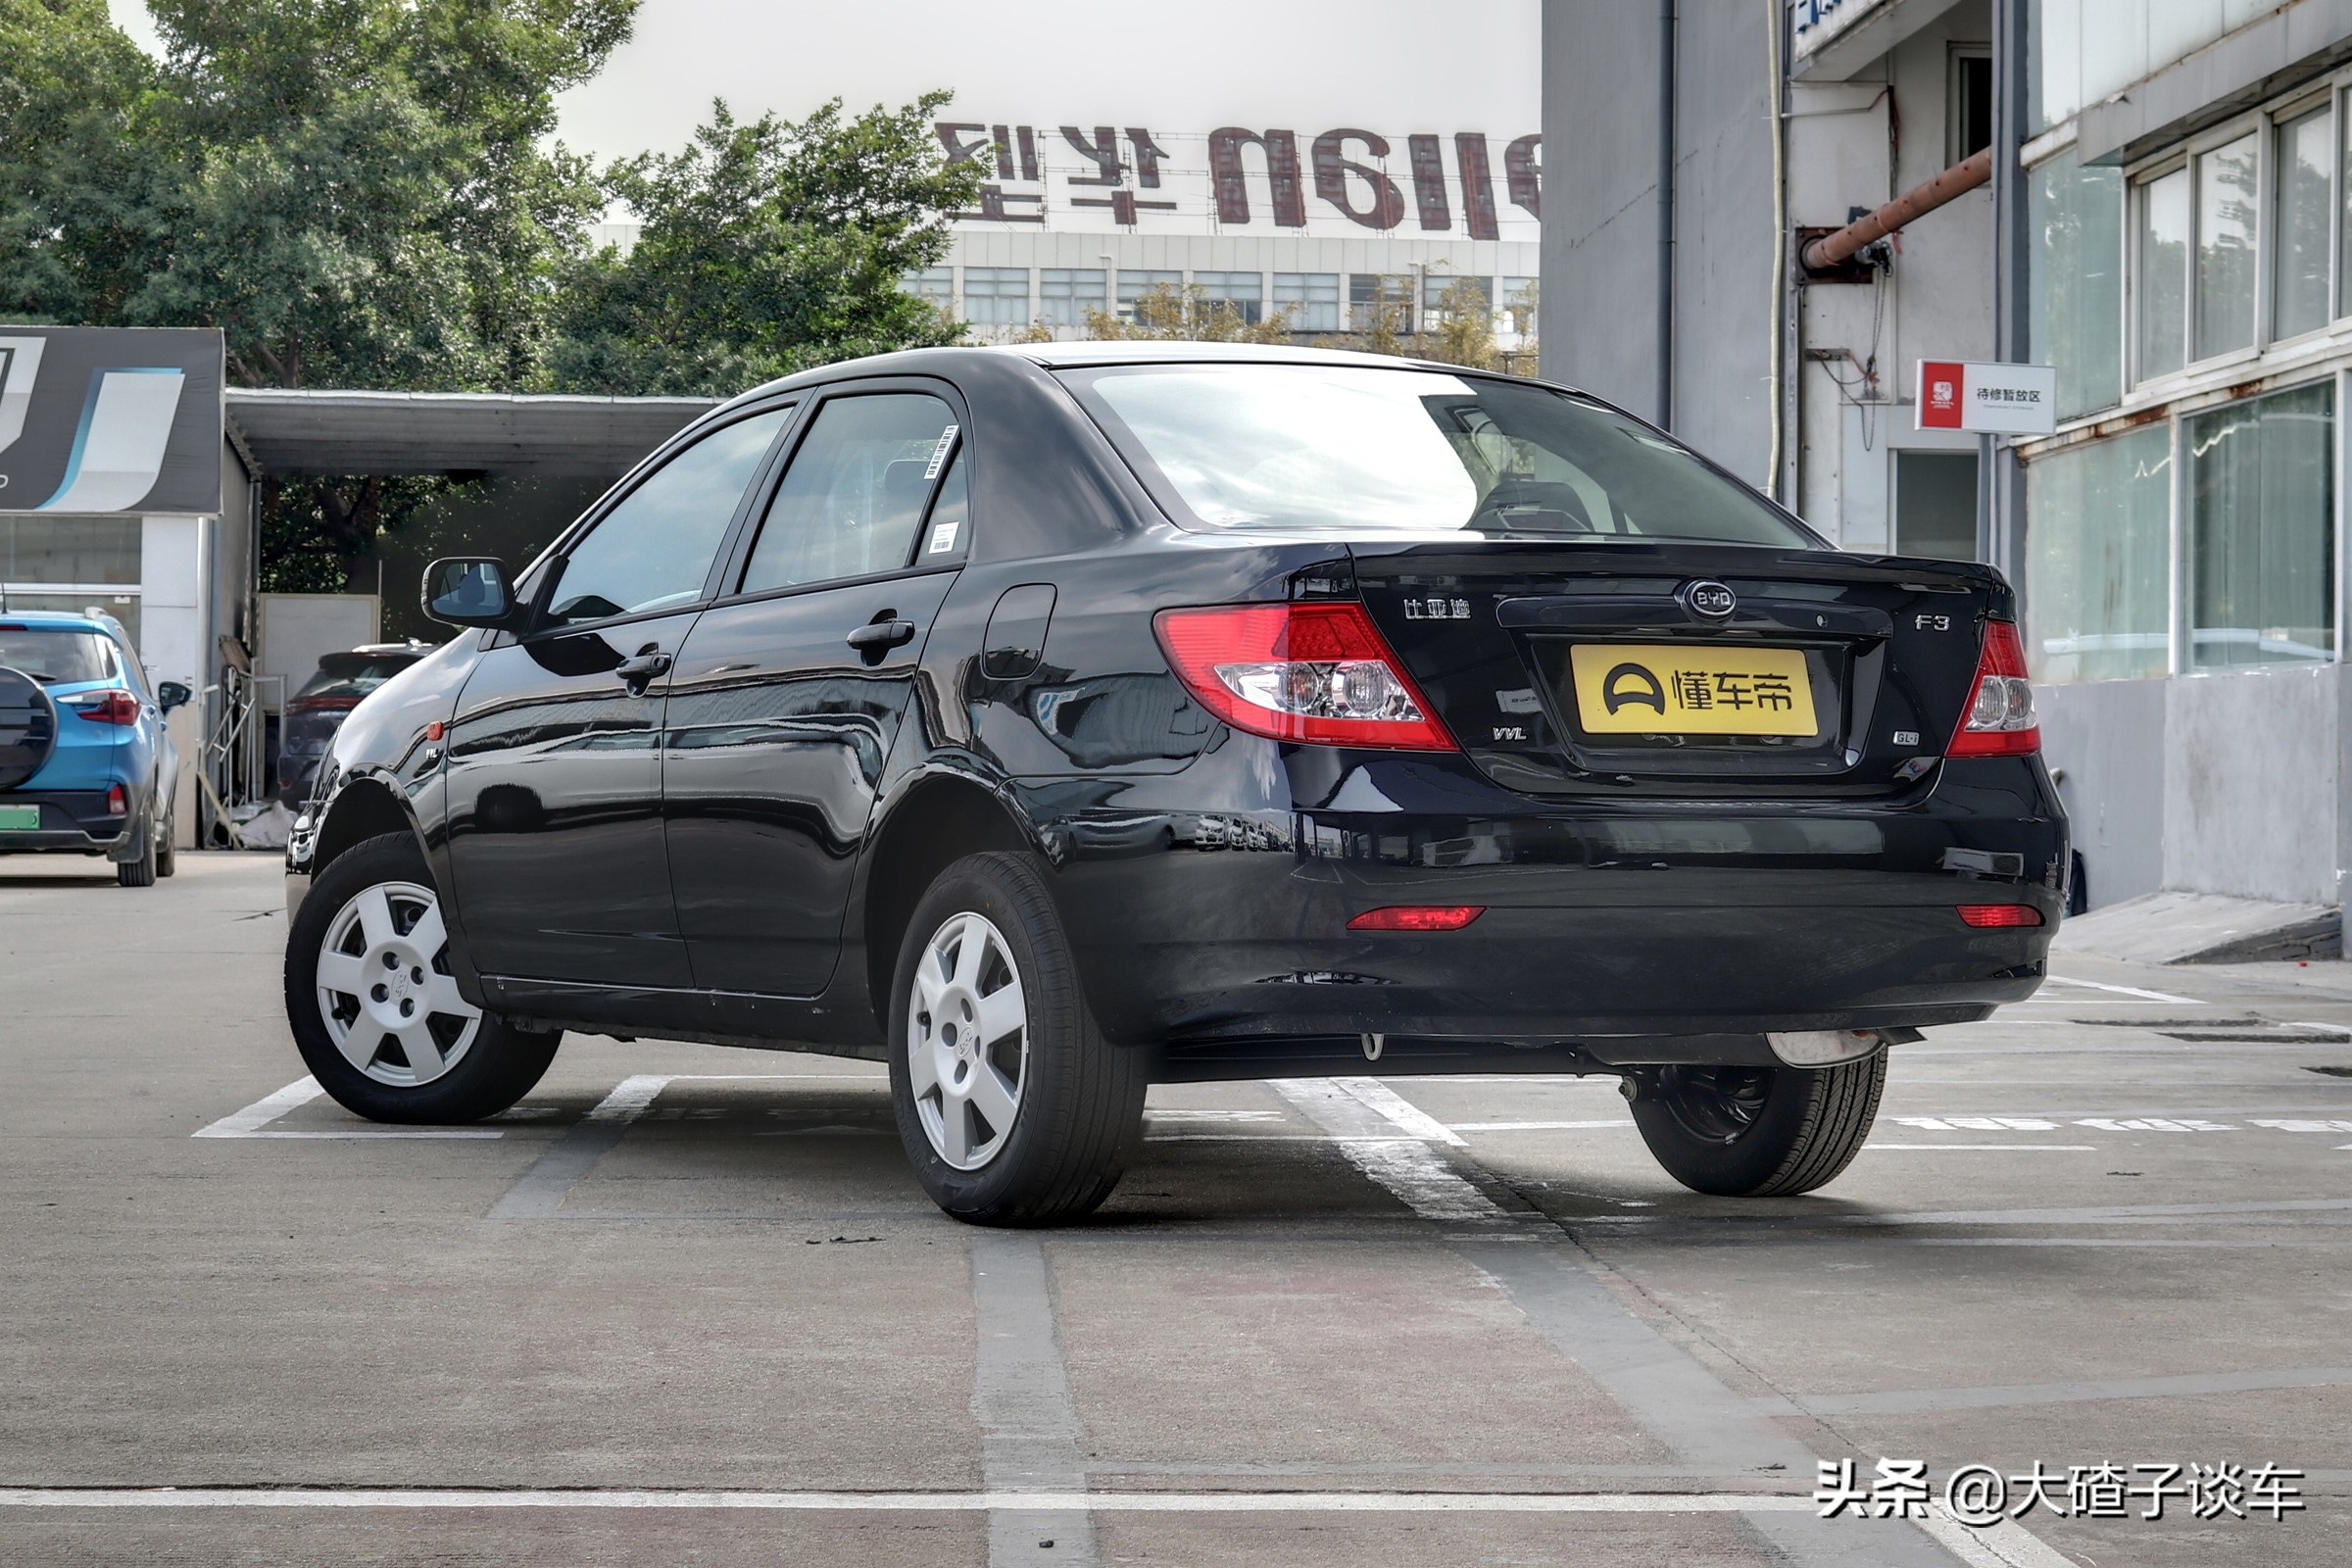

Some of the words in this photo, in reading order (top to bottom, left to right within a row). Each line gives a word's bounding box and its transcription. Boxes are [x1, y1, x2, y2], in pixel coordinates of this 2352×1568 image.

[1977, 388, 2040, 403] 待修暂放区
[1696, 591, 1732, 606] BYD
[1403, 599, 1471, 619] 比亚迪
[1914, 614, 1950, 632] F3
[1671, 669, 1792, 711] 懂车帝
[1493, 727, 1527, 741] VVL
